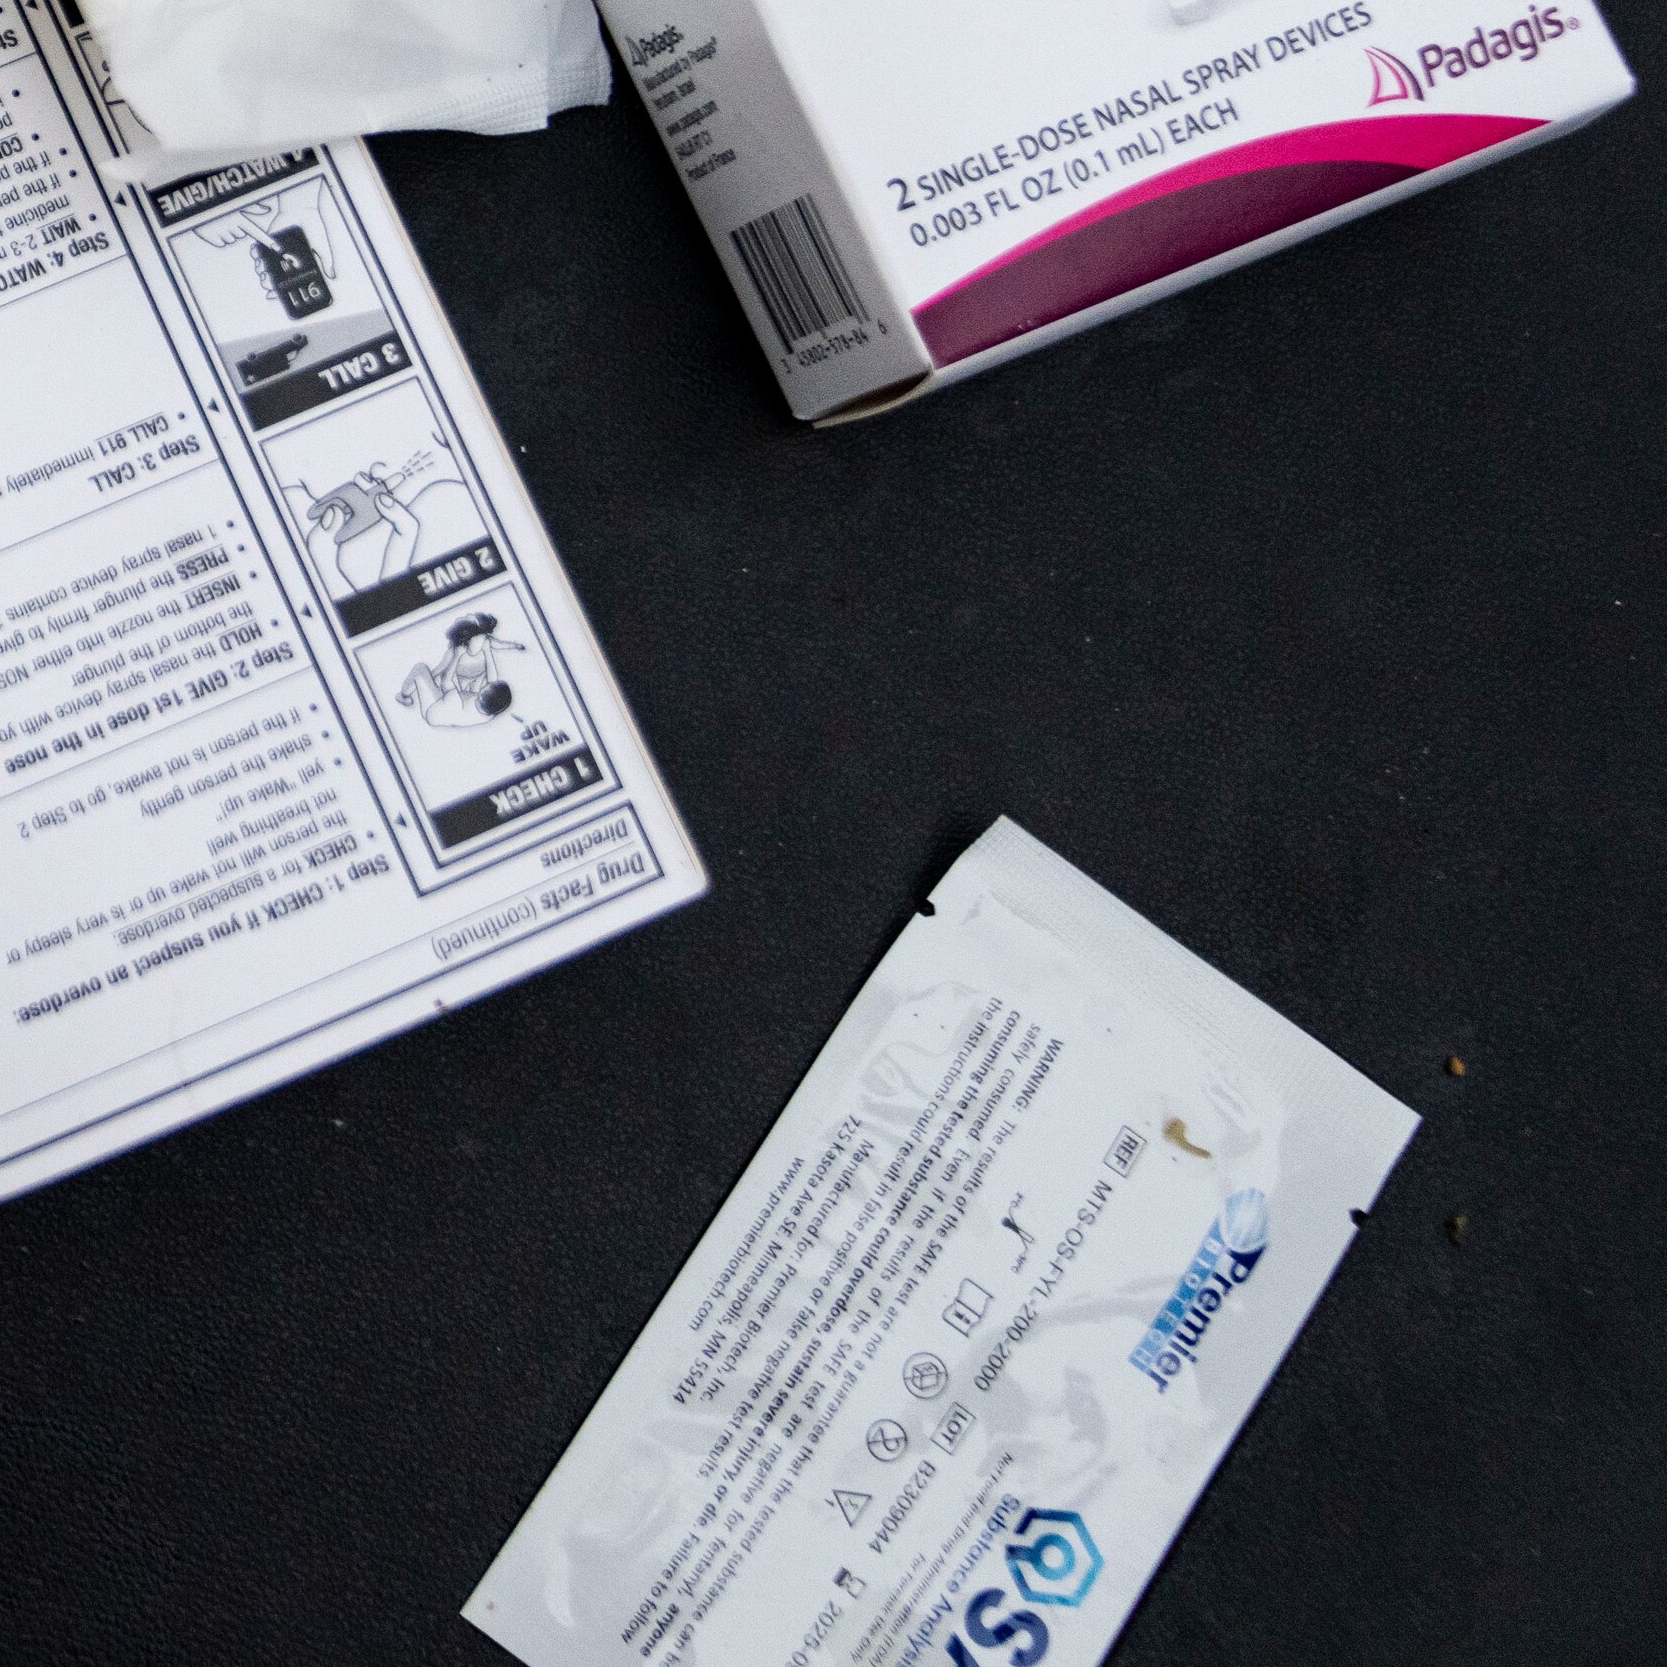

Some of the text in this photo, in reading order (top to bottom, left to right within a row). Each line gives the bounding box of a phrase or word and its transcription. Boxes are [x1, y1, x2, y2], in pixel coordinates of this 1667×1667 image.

[886, 1, 1373, 212] 2 SINGLE-DOSE NASAL SPRAY DEVICES
[909, 97, 1239, 248] 0.003 FL OZ (0.1 mL) EACH
[317, 340, 403, 394] 3 CALL
[90, 435, 201, 492] Step 3: CALL
[415, 545, 497, 597] 2 GIVE
[487, 754, 592, 816] 1 CHECK
[868, 1135, 1143, 1554] REF MTS-OS-FYL-200-2000 LOT B2309044
[1138, 1242, 1259, 1401] Premier
